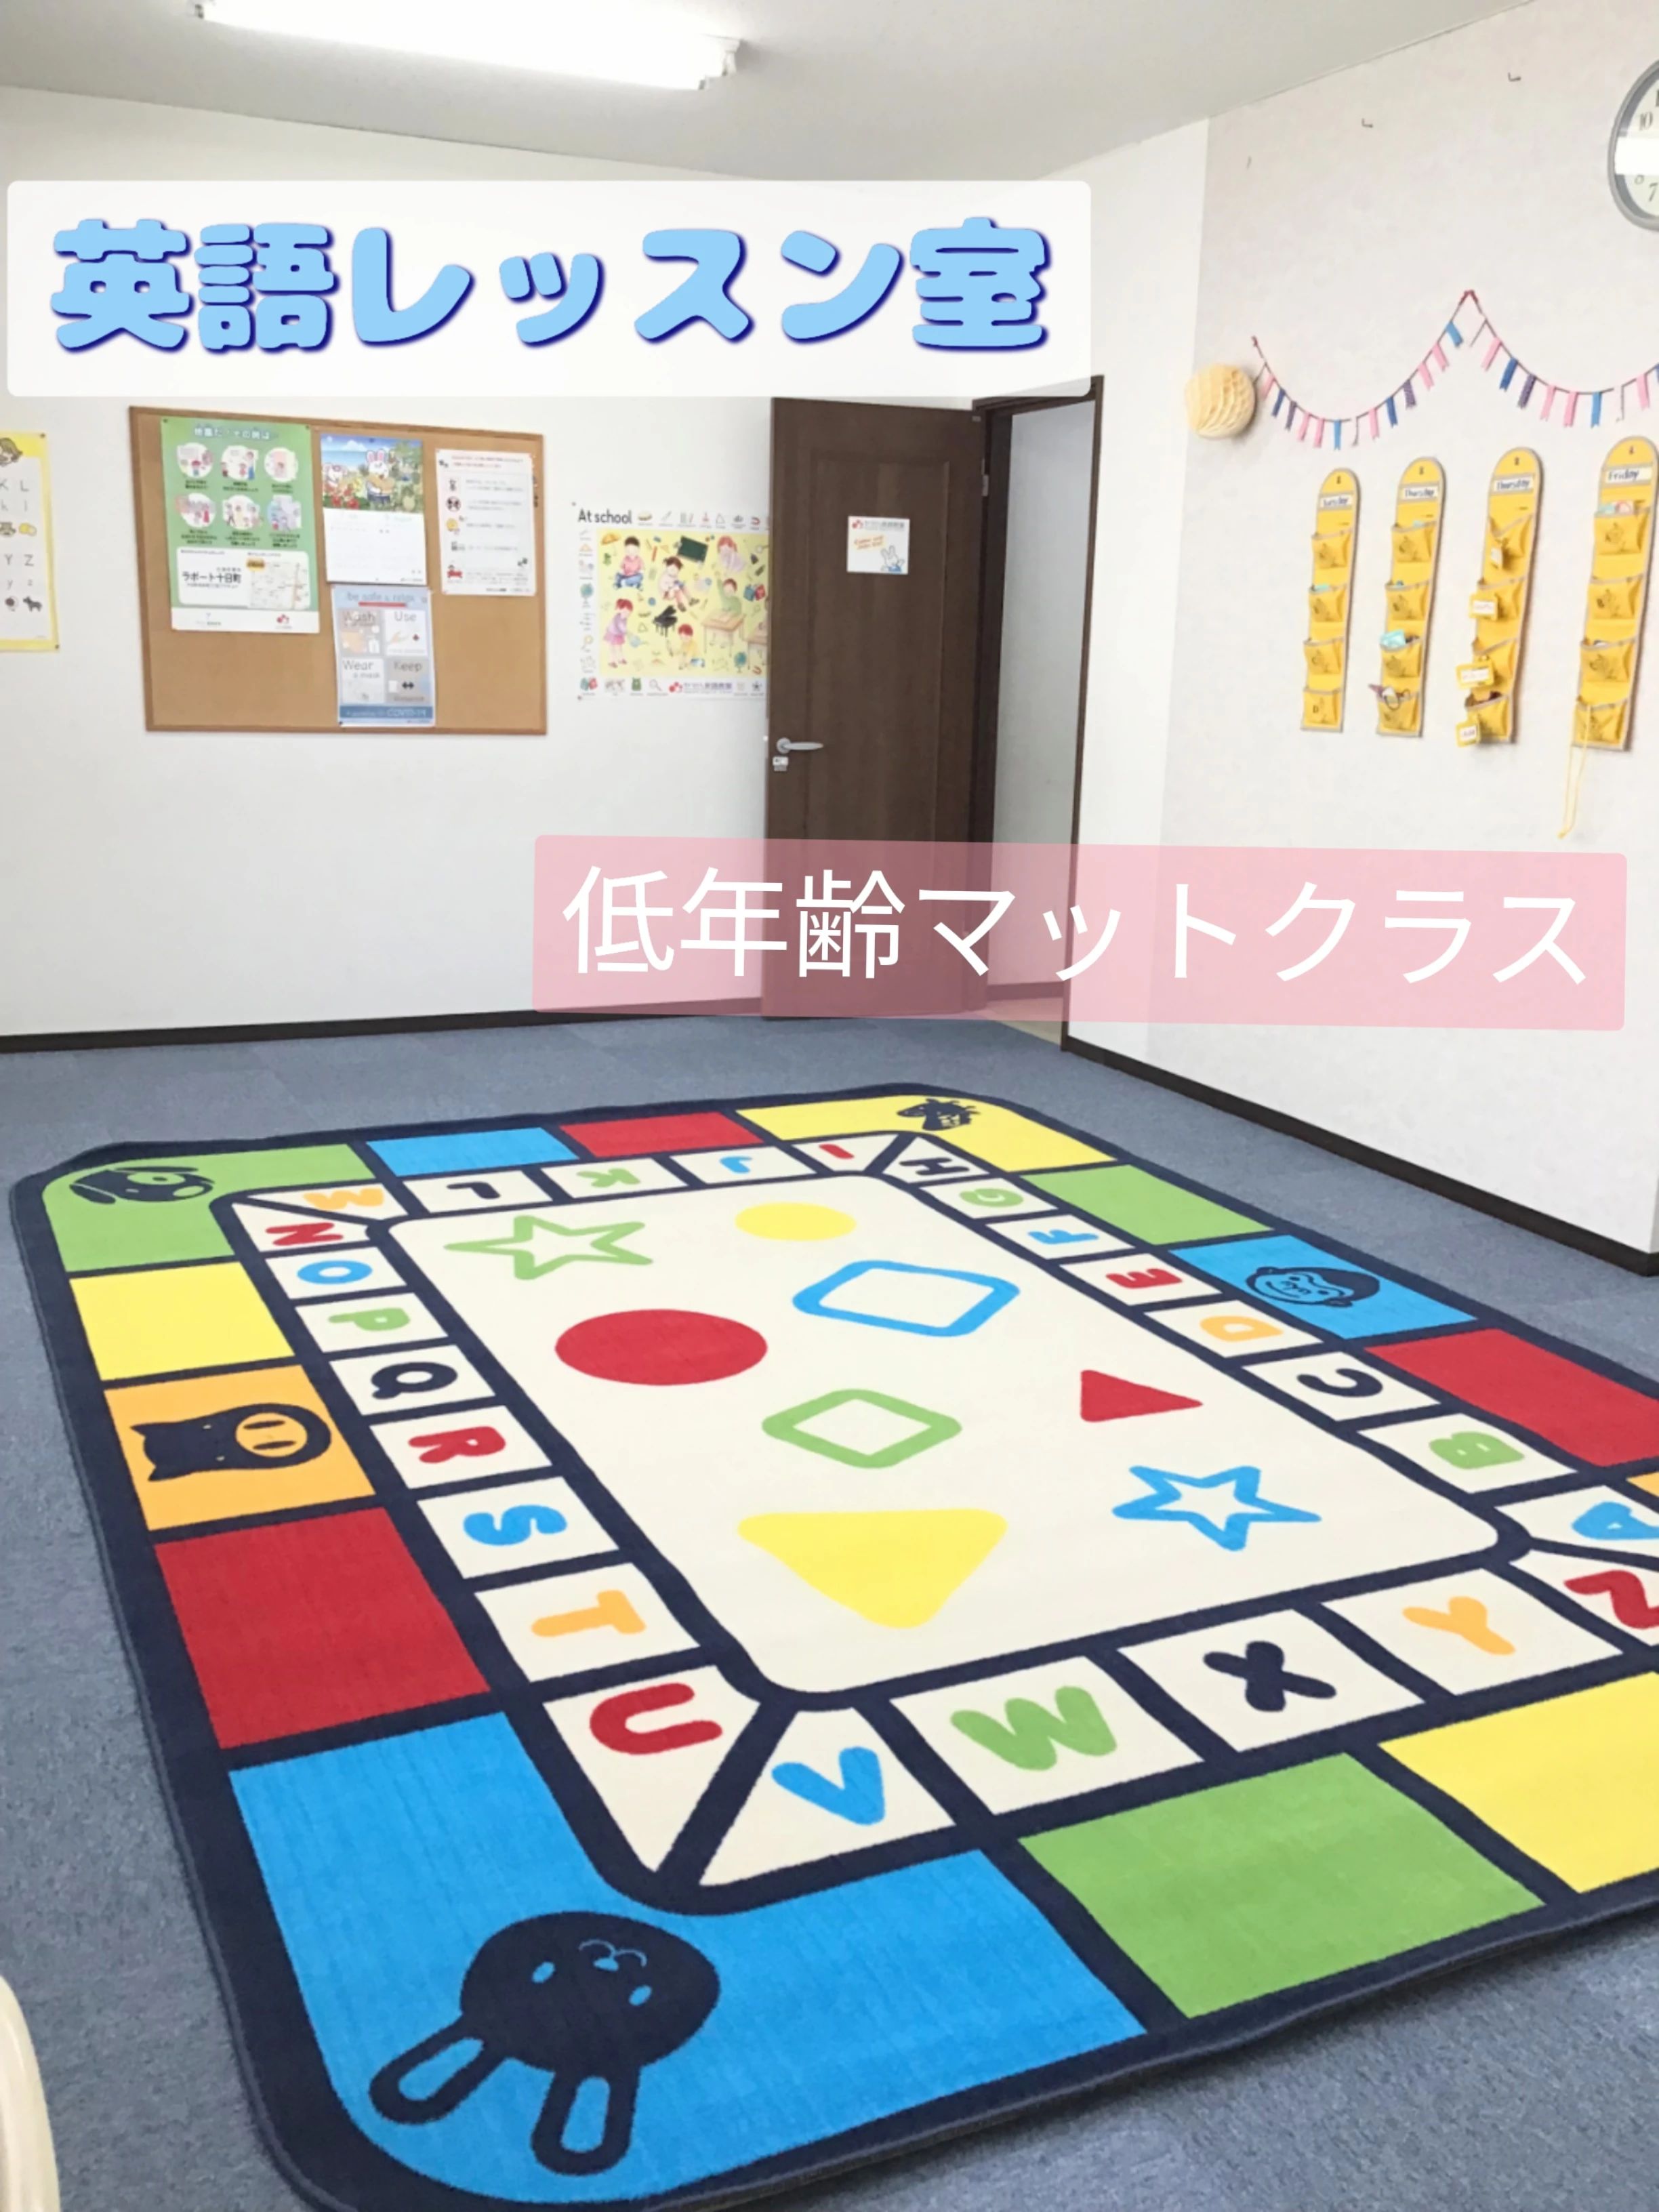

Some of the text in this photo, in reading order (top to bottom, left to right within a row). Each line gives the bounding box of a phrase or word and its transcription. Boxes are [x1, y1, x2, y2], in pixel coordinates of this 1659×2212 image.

[1639, 112, 1654, 131] 10
[20, 480, 29, 492] L
[1609, 469, 1639, 481] Friday
[578, 508, 633, 525] At school
[4, 554, 35, 567] Y Z
[394, 611, 417, 622] Use
[342, 659, 374, 671] Wear
[393, 661, 423, 673] Keep
[578, 1168, 640, 1189] K
[296, 1259, 373, 1286] O
[328, 1307, 411, 1332] P
[899, 1156, 970, 1176] H
[959, 1187, 1025, 1209] G
[1027, 1229, 1099, 1245] F
[1105, 1267, 1183, 1290] E
[1198, 1314, 1284, 1344] D
[1296, 1368, 1383, 1398] C
[1429, 1430, 1525, 1471] B
[370, 1361, 459, 1400] Q
[407, 1425, 507, 1465] R
[462, 1504, 568, 1547] S
[528, 1588, 648, 1639] T
[770, 1569, 1659, 1826] V W X Y Z
[587, 1681, 725, 1757] U
